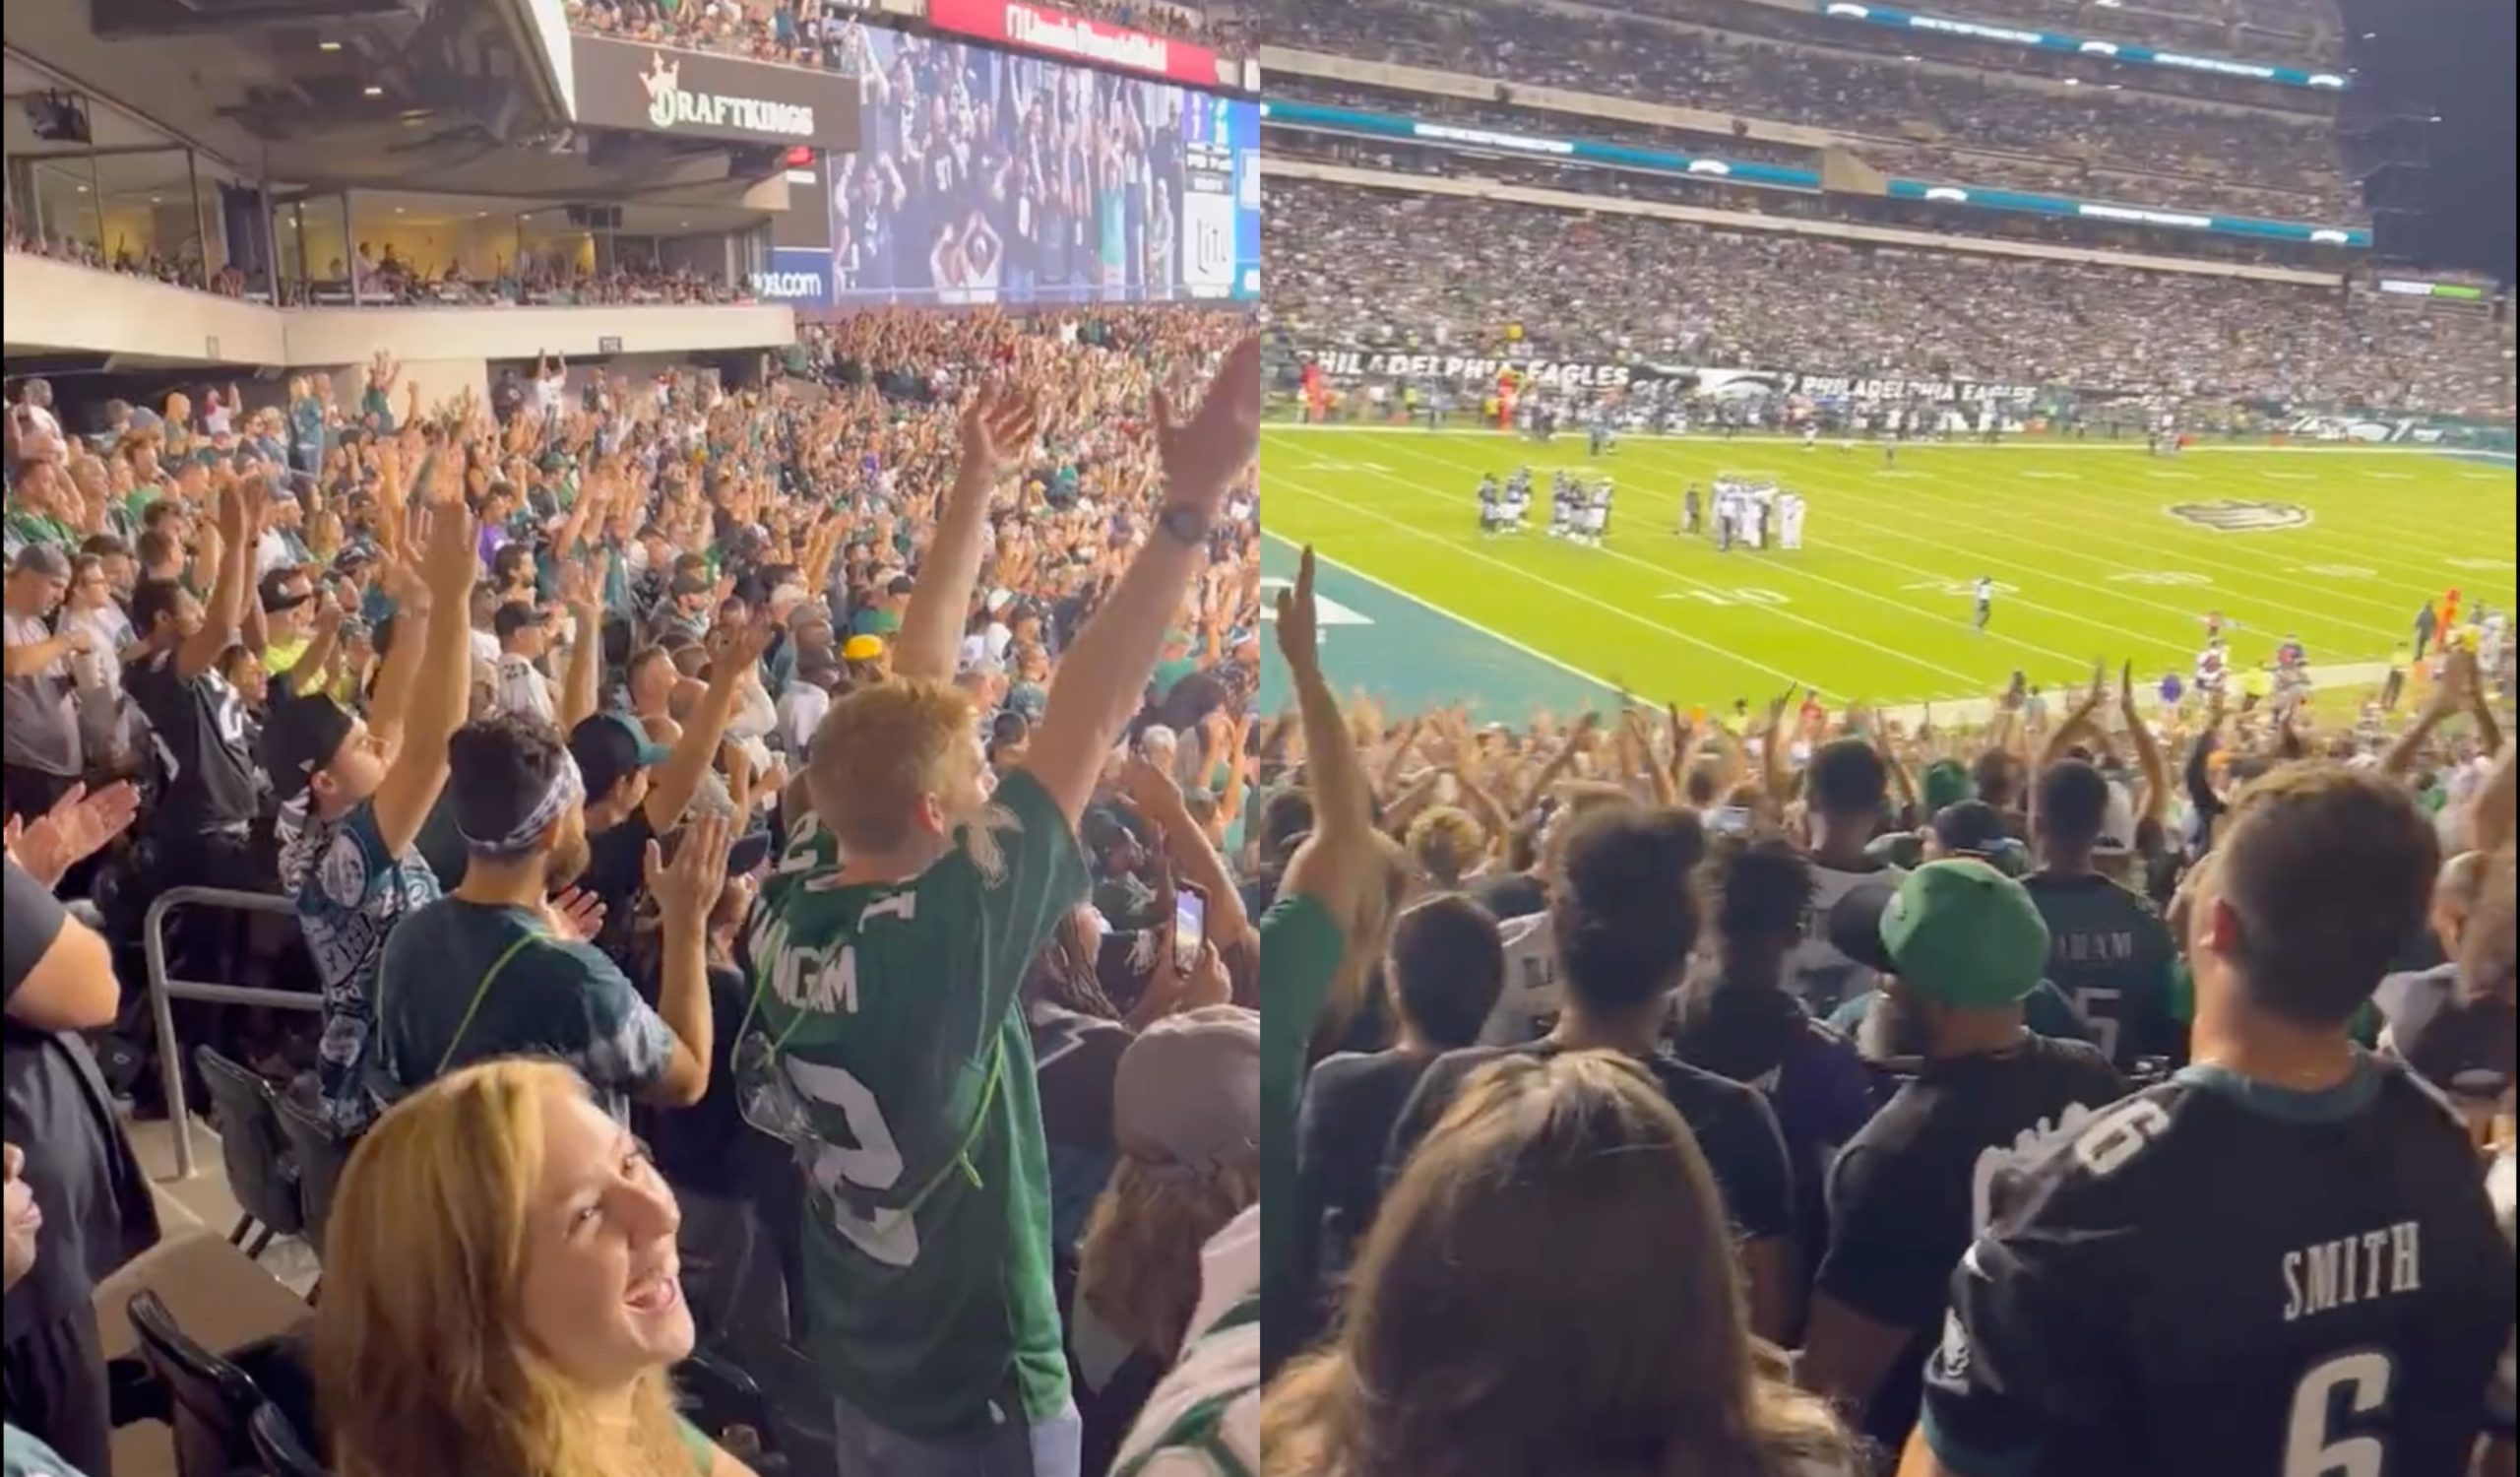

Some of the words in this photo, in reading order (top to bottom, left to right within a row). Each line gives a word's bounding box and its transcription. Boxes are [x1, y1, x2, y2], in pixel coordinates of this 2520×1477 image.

[649, 87, 815, 137] DRAFTKINGS
[1528, 358, 1631, 387] EAGLES
[2074, 1099, 2170, 1176] 6
[2283, 1222, 2421, 1321] SMITH
[2285, 1352, 2392, 1477] 6
